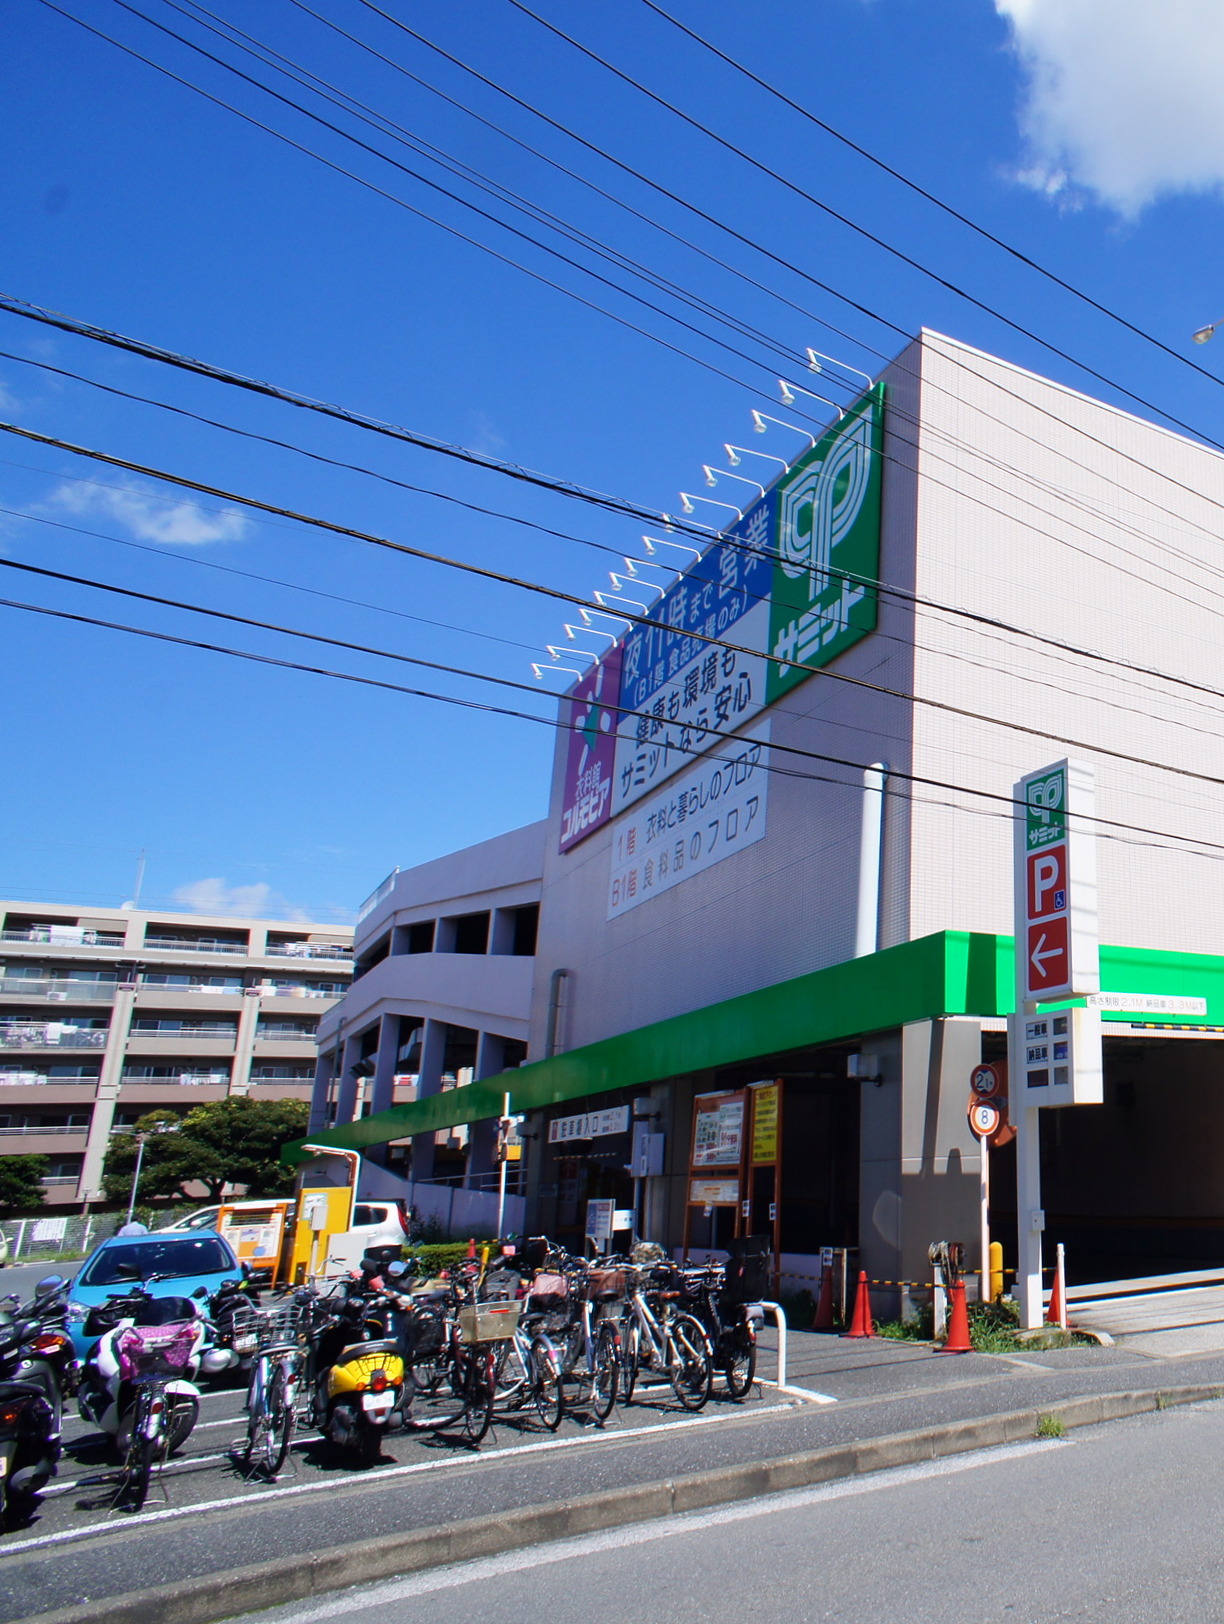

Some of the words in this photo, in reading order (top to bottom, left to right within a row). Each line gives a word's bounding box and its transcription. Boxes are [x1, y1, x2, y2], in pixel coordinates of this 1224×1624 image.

[774, 575, 865, 679] サミット
[561, 777, 610, 844] コルモピア
[646, 744, 763, 845] 衣料と暮らしのフロア
[642, 794, 760, 890] 食料品のフロア
[1029, 821, 1062, 845] サミット
[1034, 855, 1059, 913] P
[981, 1109, 989, 1125] 8
